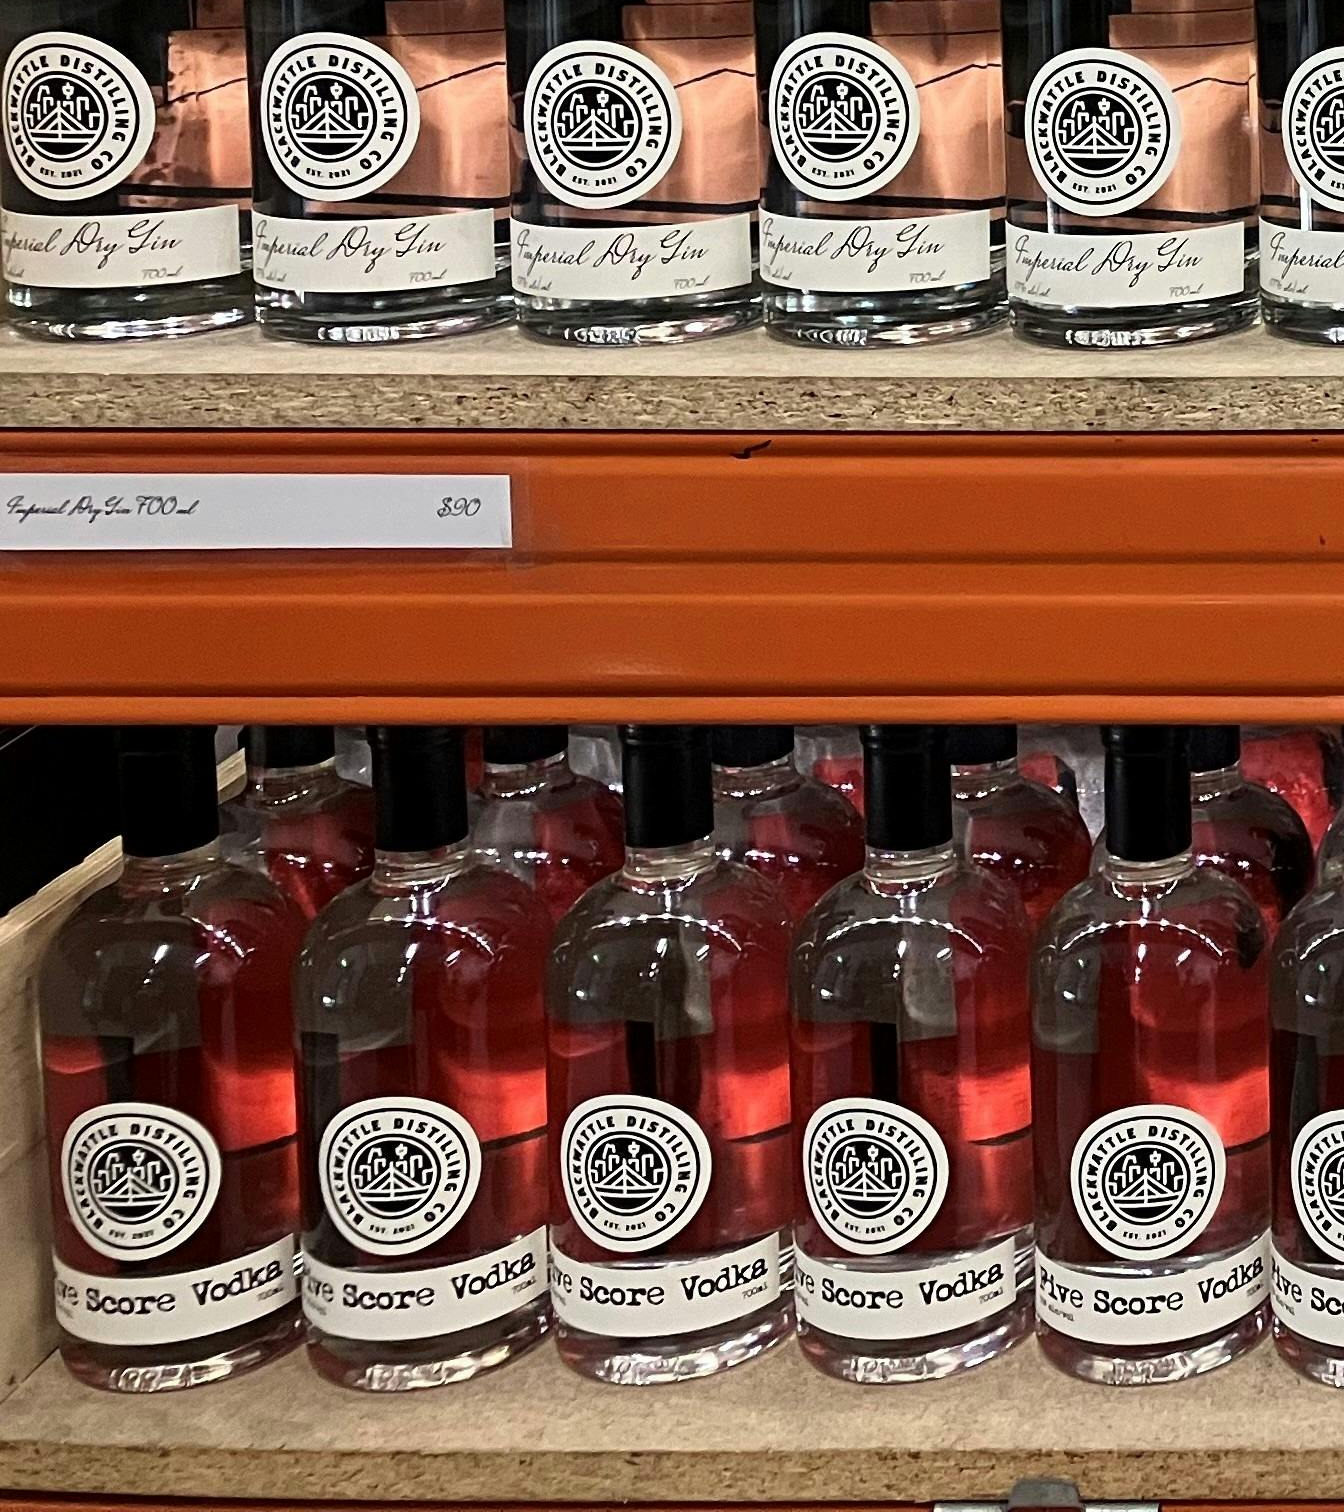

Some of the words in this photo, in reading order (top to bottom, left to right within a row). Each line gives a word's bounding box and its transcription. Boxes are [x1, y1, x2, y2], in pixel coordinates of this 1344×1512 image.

[1038, 71, 1084, 184] BLACKWATTLE
[1097, 71, 1160, 156] DISTILLING
[1125, 165, 1147, 186] CO
[60, 222, 117, 269] Dry
[128, 219, 182, 254] Gin
[326, 226, 391, 273] Dry
[395, 223, 445, 257] Gin
[517, 229, 595, 272] Imperial
[593, 233, 656, 280] Dry
[660, 230, 708, 264] Gin
[764, 218, 831, 262] Imperial
[828, 226, 892, 274] Dry
[896, 224, 944, 258] Gin
[1015, 235, 1093, 281] Imperial
[1093, 242, 1155, 288] Dry
[1157, 238, 1202, 272] Gin
[437, 497, 481, 518] $90
[1087, 1126, 1137, 1231] BLACKWATTLE
[1148, 1125, 1207, 1198] DISTILLING
[1174, 1208, 1194, 1229] CO
[86, 1288, 176, 1316] Score
[191, 1259, 284, 1305] Vodka
[342, 1285, 434, 1311] Score
[452, 1250, 536, 1299] Vodka
[580, 1276, 664, 1308] Score
[680, 1257, 768, 1301] Vodka
[822, 1278, 904, 1309] Score
[919, 1262, 1003, 1306] Vodka
[1094, 1288, 1184, 1316] Score
